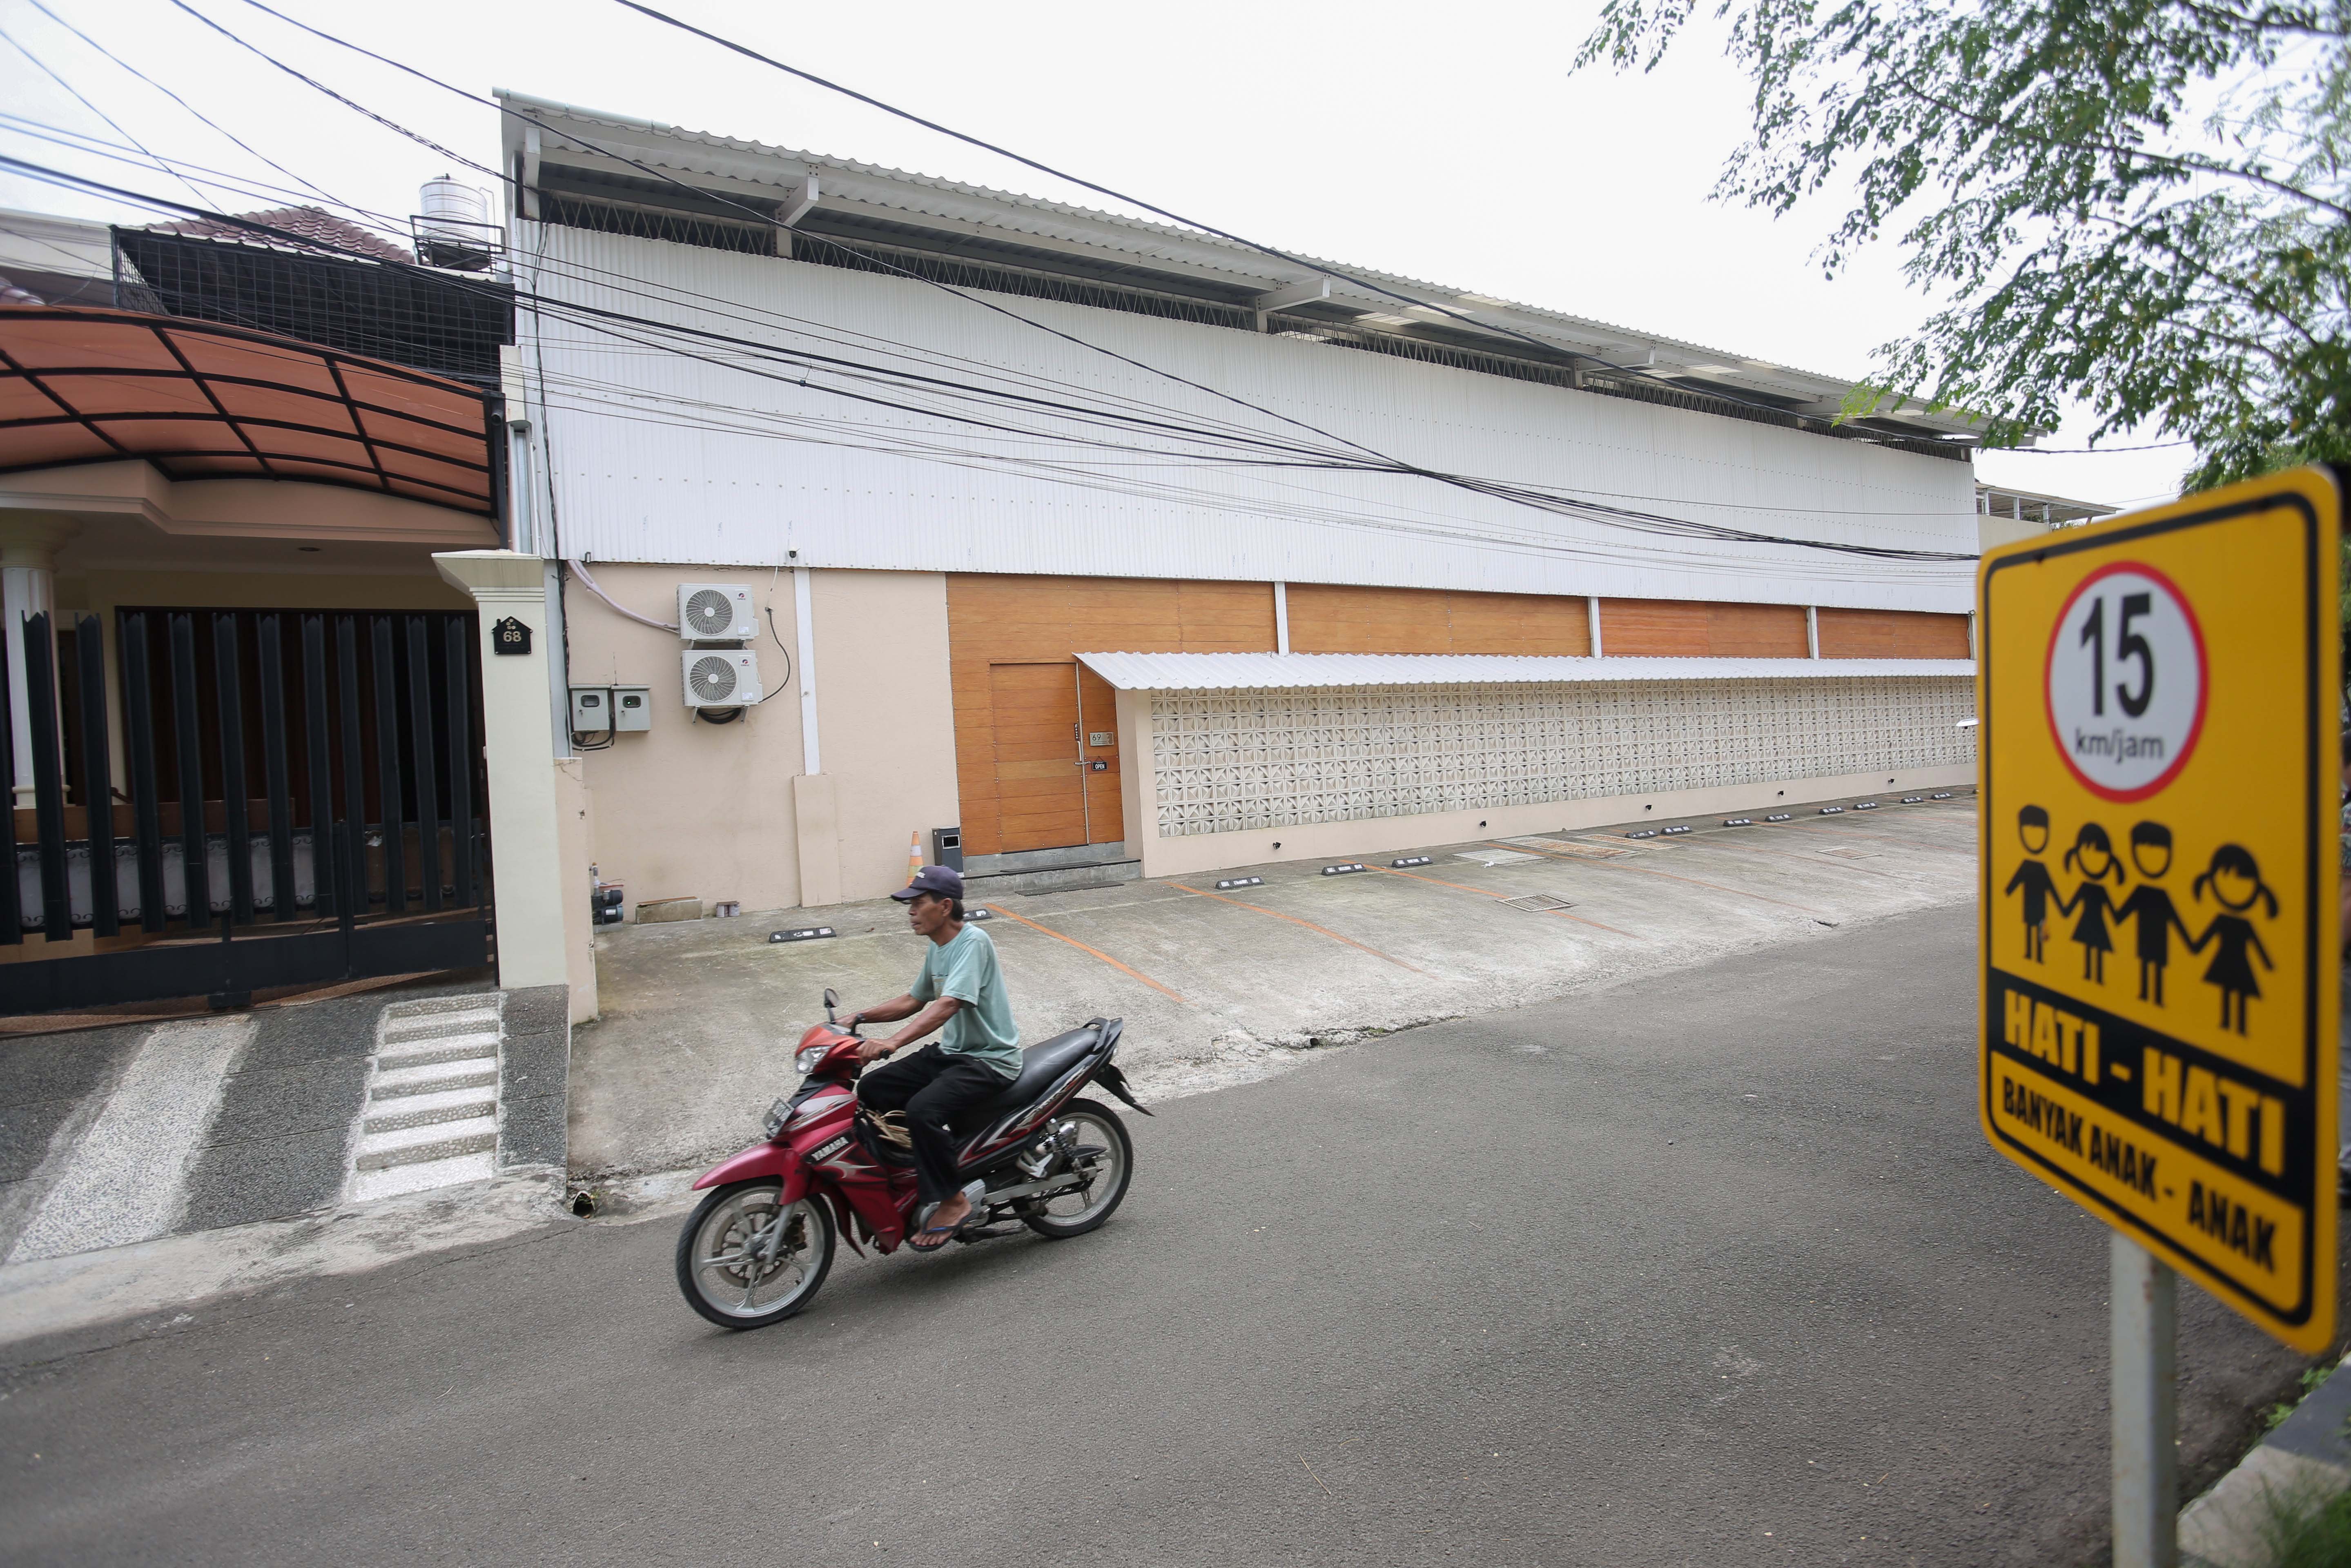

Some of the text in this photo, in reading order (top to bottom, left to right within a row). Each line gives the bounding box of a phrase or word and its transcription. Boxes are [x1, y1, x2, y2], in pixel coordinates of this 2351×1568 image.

[503, 631, 522, 642] 68
[2080, 591, 2154, 719] 15
[2075, 728, 2164, 763] km/jam
[2004, 988, 2100, 1086] HATI
[2142, 1045, 2286, 1179] HATI
[811, 1136, 849, 1161] YAMAHA
[2003, 1075, 2084, 1159] BANYAK
[2088, 1124, 2158, 1203] ANAK
[2187, 1180, 2277, 1275] ANAK
